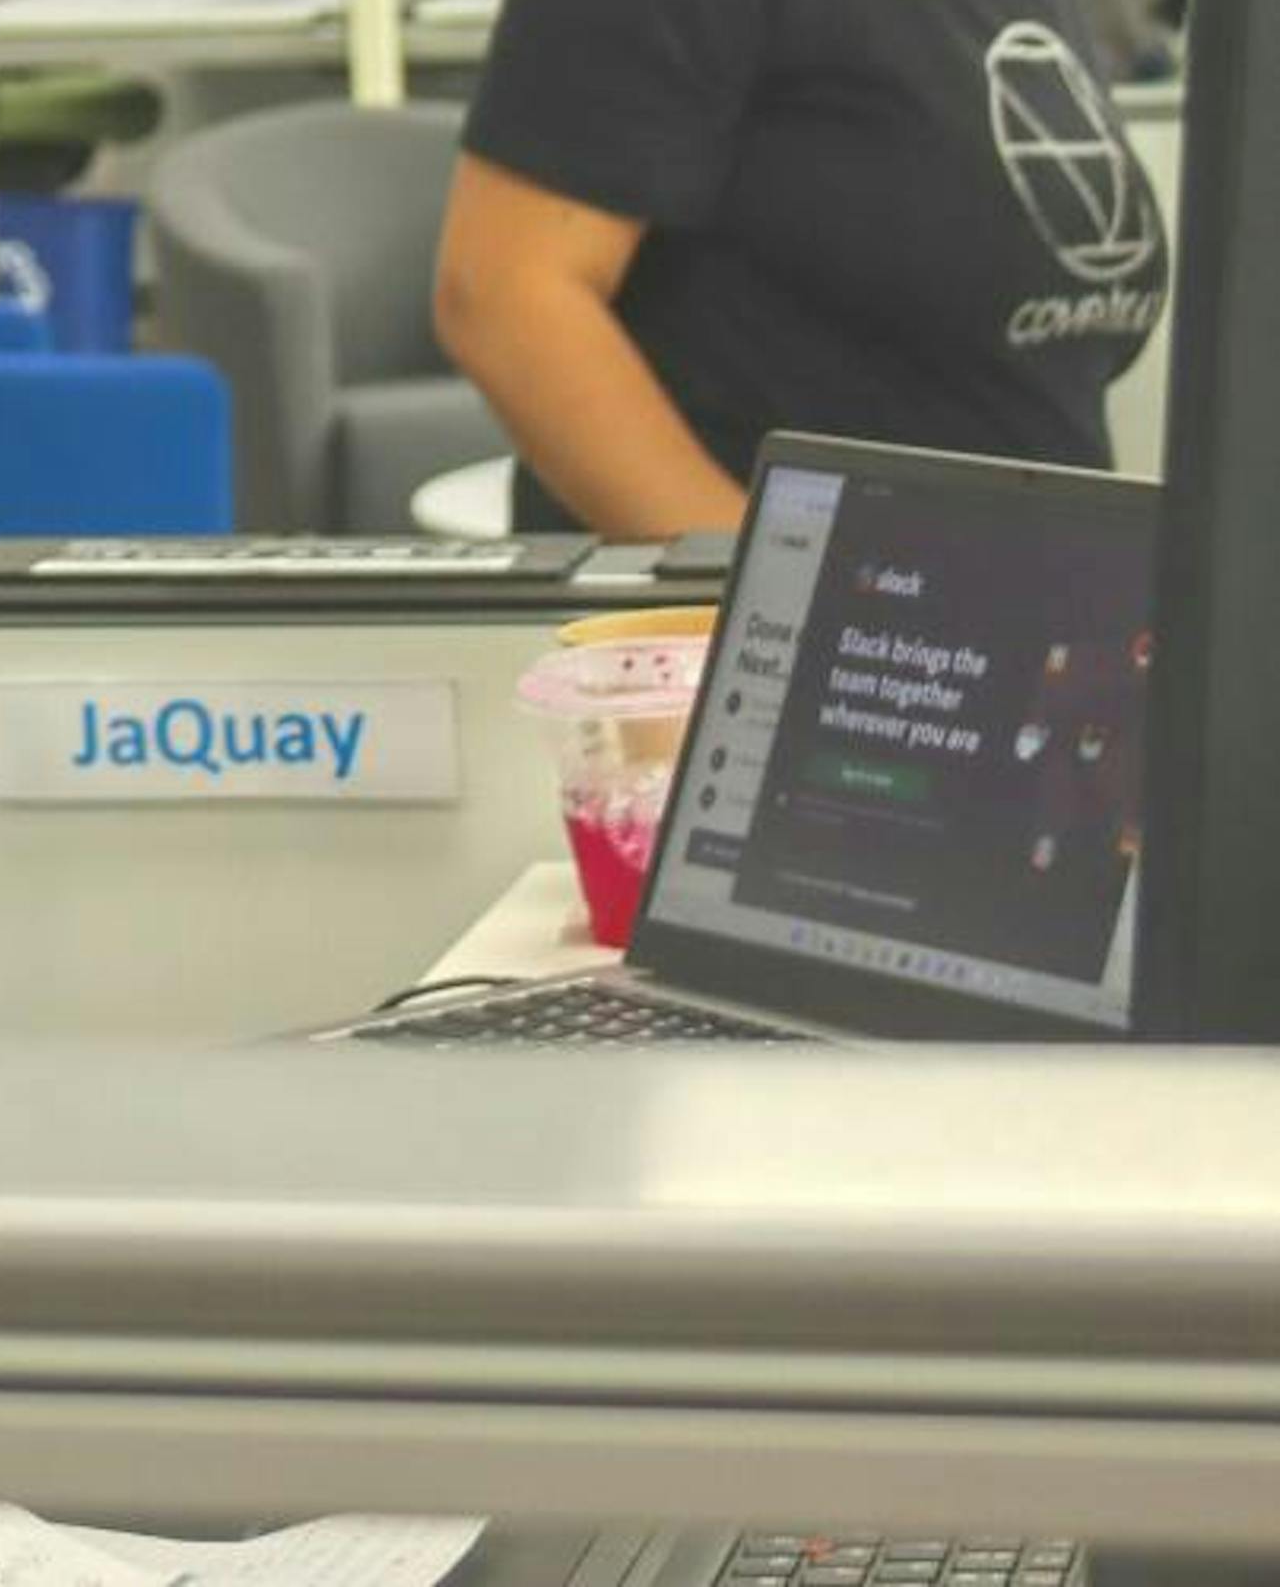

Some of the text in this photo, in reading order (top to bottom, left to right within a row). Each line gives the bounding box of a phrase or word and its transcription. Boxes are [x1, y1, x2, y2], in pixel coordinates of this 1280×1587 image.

[839, 626, 987, 677] Slack brings the
[830, 666, 963, 710] team together
[72, 698, 366, 778] JaQuay
[819, 701, 981, 753] wherever you are
